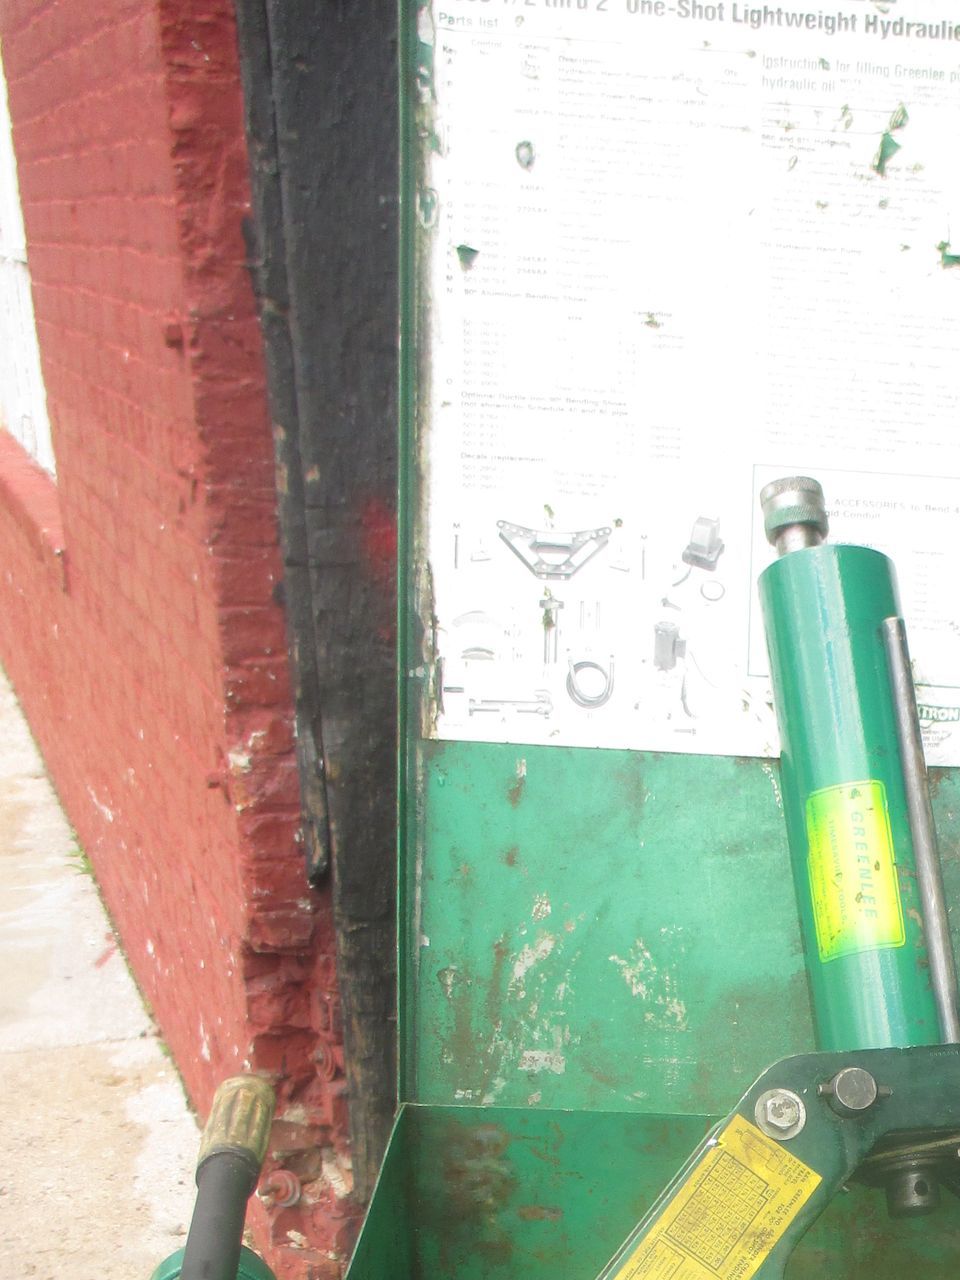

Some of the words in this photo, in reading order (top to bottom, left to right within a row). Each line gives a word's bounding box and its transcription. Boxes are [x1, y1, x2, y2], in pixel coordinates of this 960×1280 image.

[438, 12, 473, 27] Parts
[479, 16, 499, 28] list
[626, 0, 725, 22] One-Shot
[731, 4, 857, 35] Lightweight
[894, 64, 945, 80] Greenlee
[762, 75, 817, 92] hydraulic
[851, 811, 878, 918] GREENLEE
